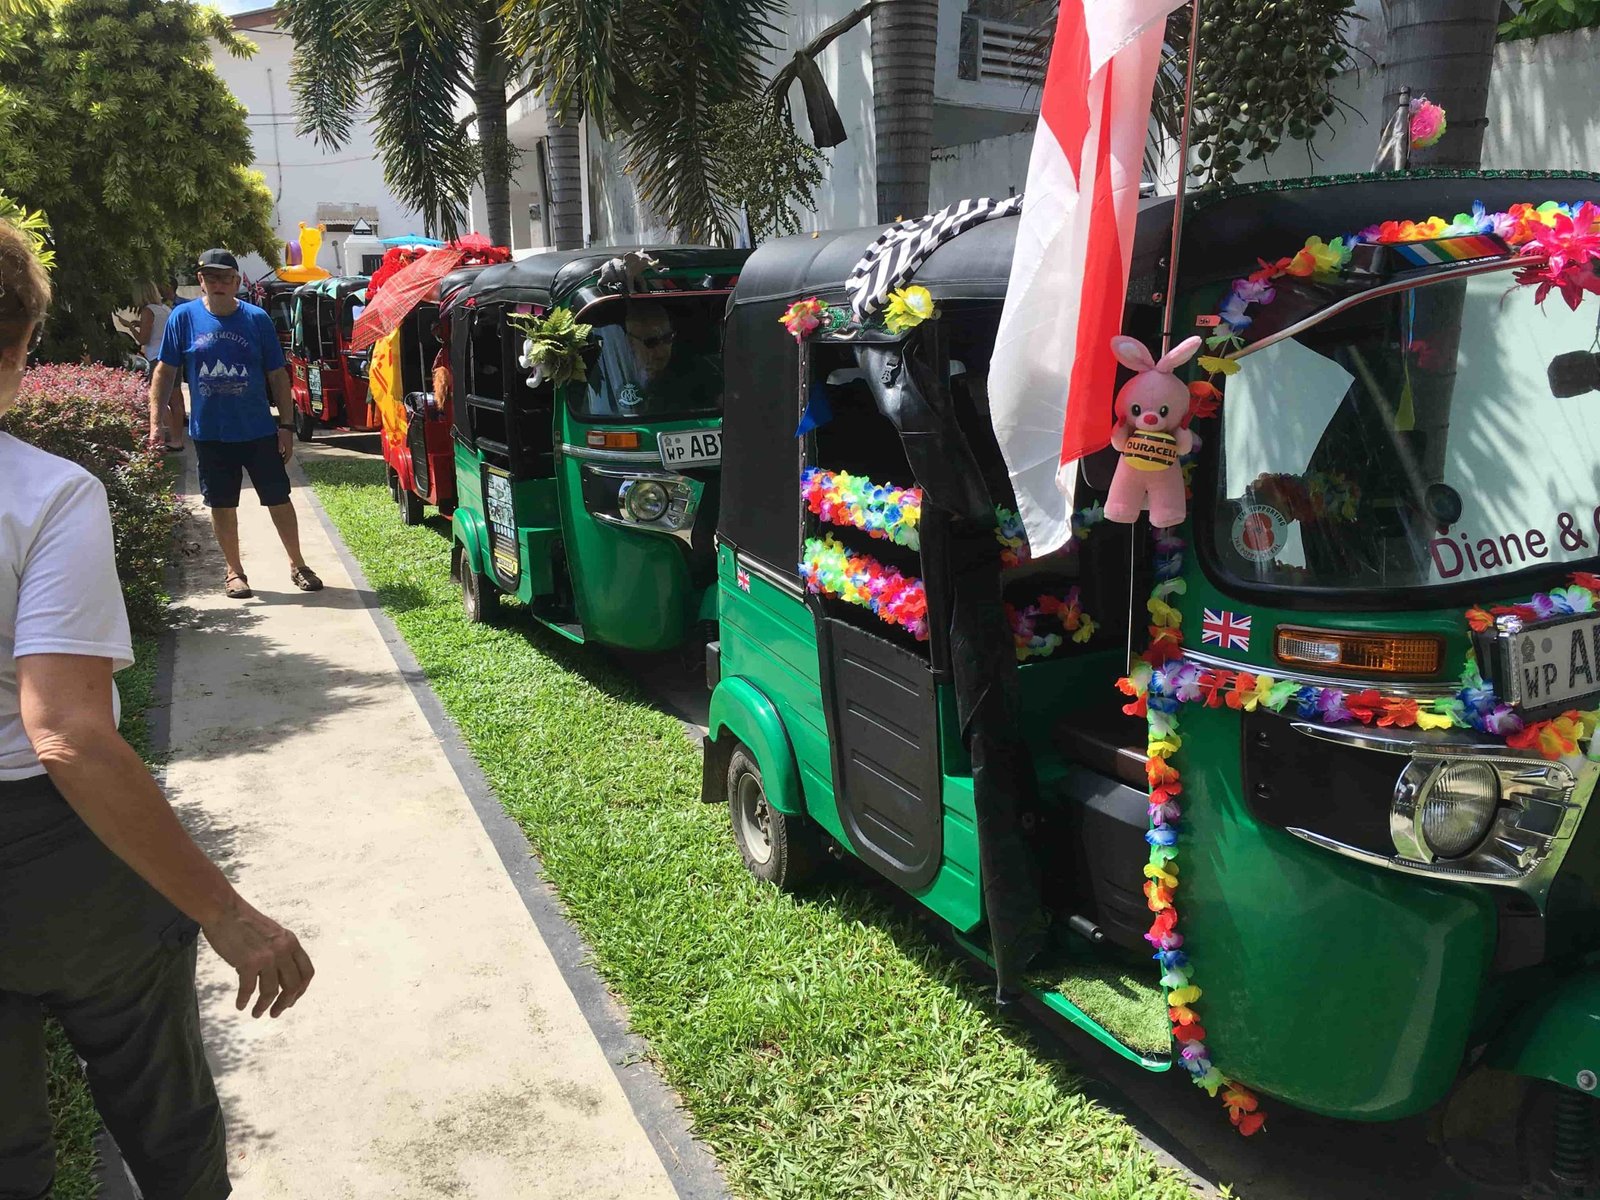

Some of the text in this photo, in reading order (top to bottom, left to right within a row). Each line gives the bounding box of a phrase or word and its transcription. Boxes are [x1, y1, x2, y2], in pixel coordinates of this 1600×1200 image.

[667, 447, 685, 461] WP
[1429, 528, 1549, 579] Diane
[1557, 512, 1589, 552] &
[1524, 663, 1558, 699] WP
